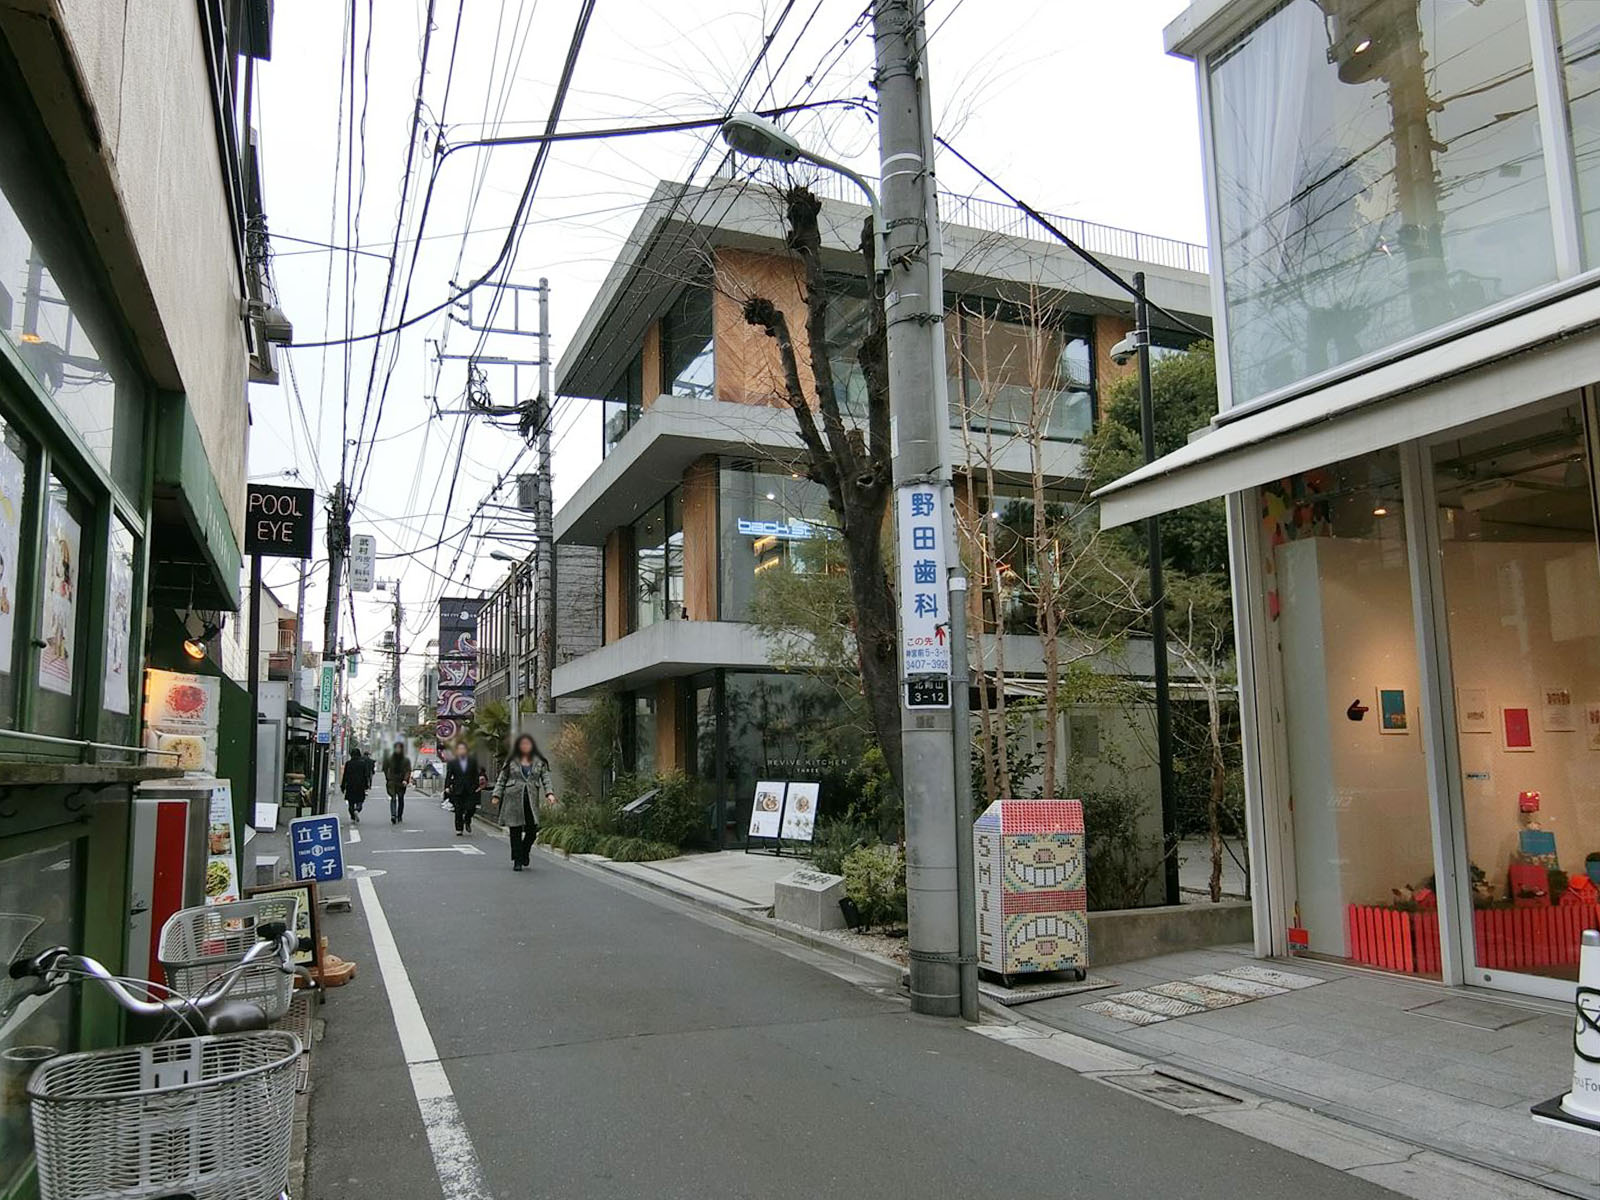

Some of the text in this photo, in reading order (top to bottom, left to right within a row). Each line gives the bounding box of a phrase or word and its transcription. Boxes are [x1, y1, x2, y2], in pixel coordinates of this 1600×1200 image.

[249, 493, 303, 517] POOL
[257, 520, 294, 542] EYE
[911, 492, 938, 620] 野田歯科
[907, 637, 934, 647] この先
[914, 692, 944, 702] 3-12
[767, 759, 847, 767] REVIVE KITCHEN
[297, 824, 333, 843] 立吉
[300, 858, 337, 879] 餃子
